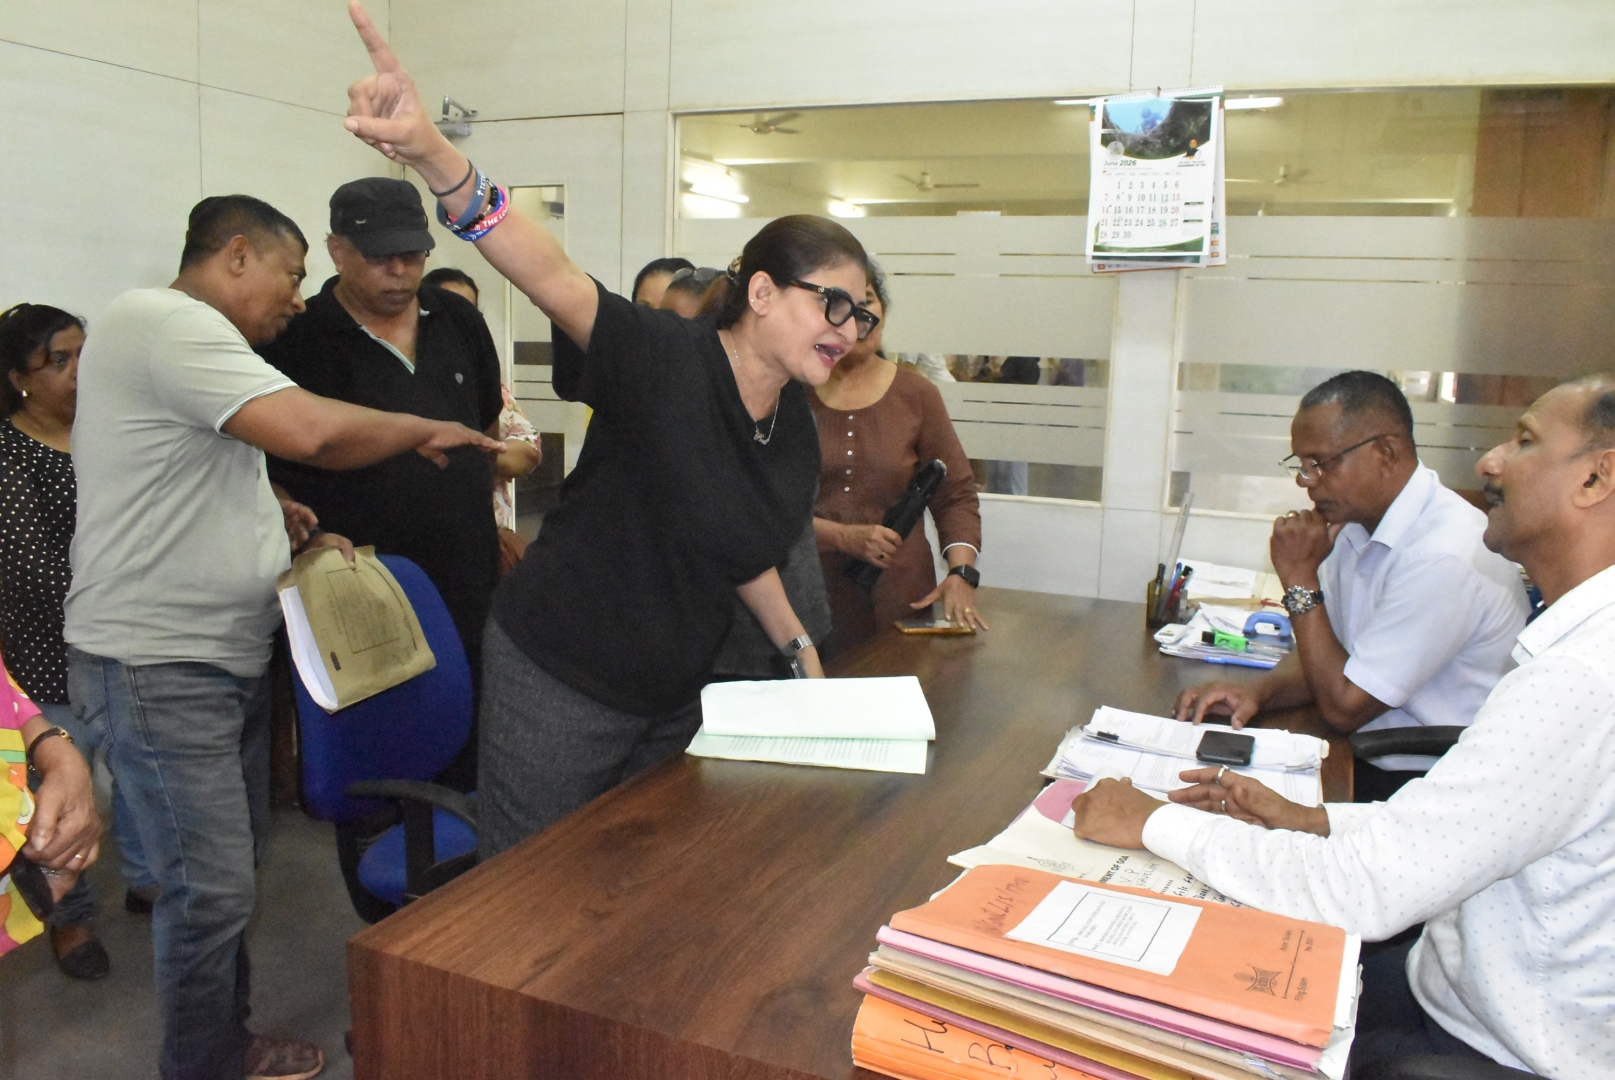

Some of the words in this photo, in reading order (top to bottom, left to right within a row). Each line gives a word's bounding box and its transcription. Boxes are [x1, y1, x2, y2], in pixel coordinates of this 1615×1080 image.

[1118, 181, 1120, 189] 1
[1129, 181, 1133, 189] 2
[1140, 181, 1144, 189] 3
[1152, 181, 1156, 189] 4
[1163, 181, 1168, 189] 5
[1174, 181, 1179, 189] 6
[1161, 193, 1169, 202] 12
[1172, 193, 1180, 201] 13
[1114, 206, 1122, 214] 15
[1171, 206, 1179, 214] 20
[482, 217, 498, 227] THE
[1116, 856, 1130, 864] GOA
